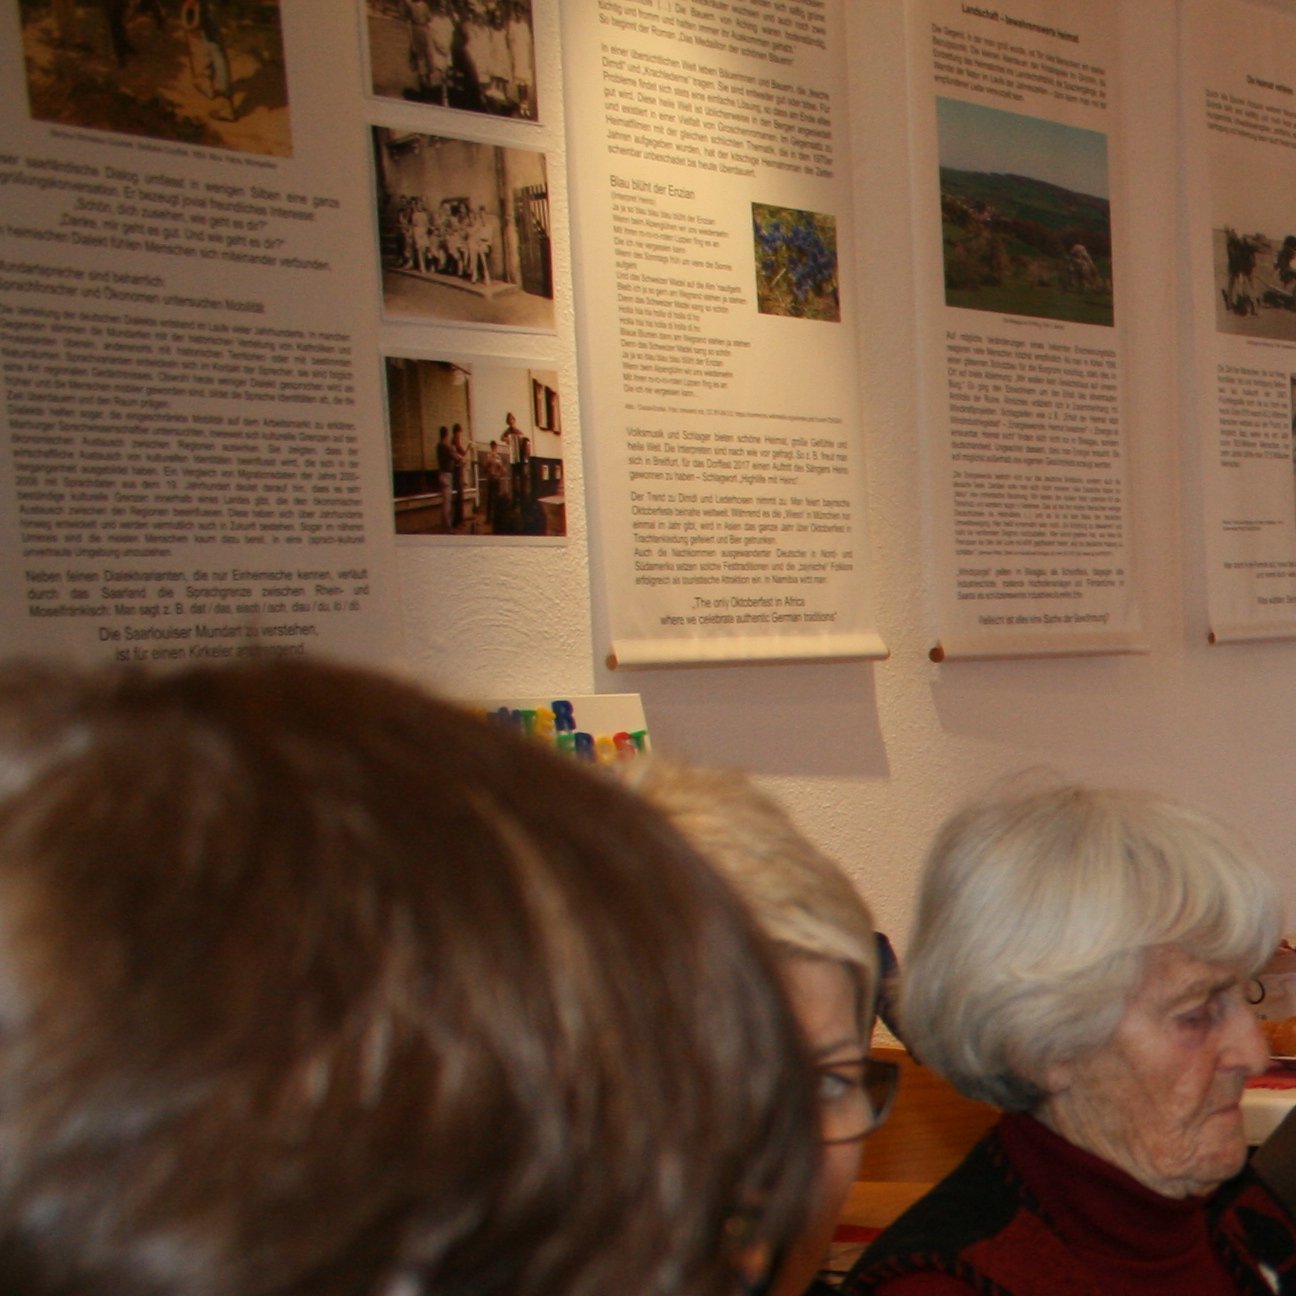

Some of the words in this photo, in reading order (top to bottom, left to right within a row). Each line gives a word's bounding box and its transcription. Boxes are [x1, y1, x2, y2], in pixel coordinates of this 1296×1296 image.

[609, 175, 630, 189] Blau
[631, 179, 652, 193] blüht
[667, 185, 696, 201] Enzian
[729, 597, 774, 608] Oktoberfest
[783, 596, 806, 607] Africa
[98, 626, 122, 642] Die
[123, 627, 192, 641] Saarlouiser
[194, 625, 244, 639] Mundart
[260, 624, 319, 637] verstehen,
